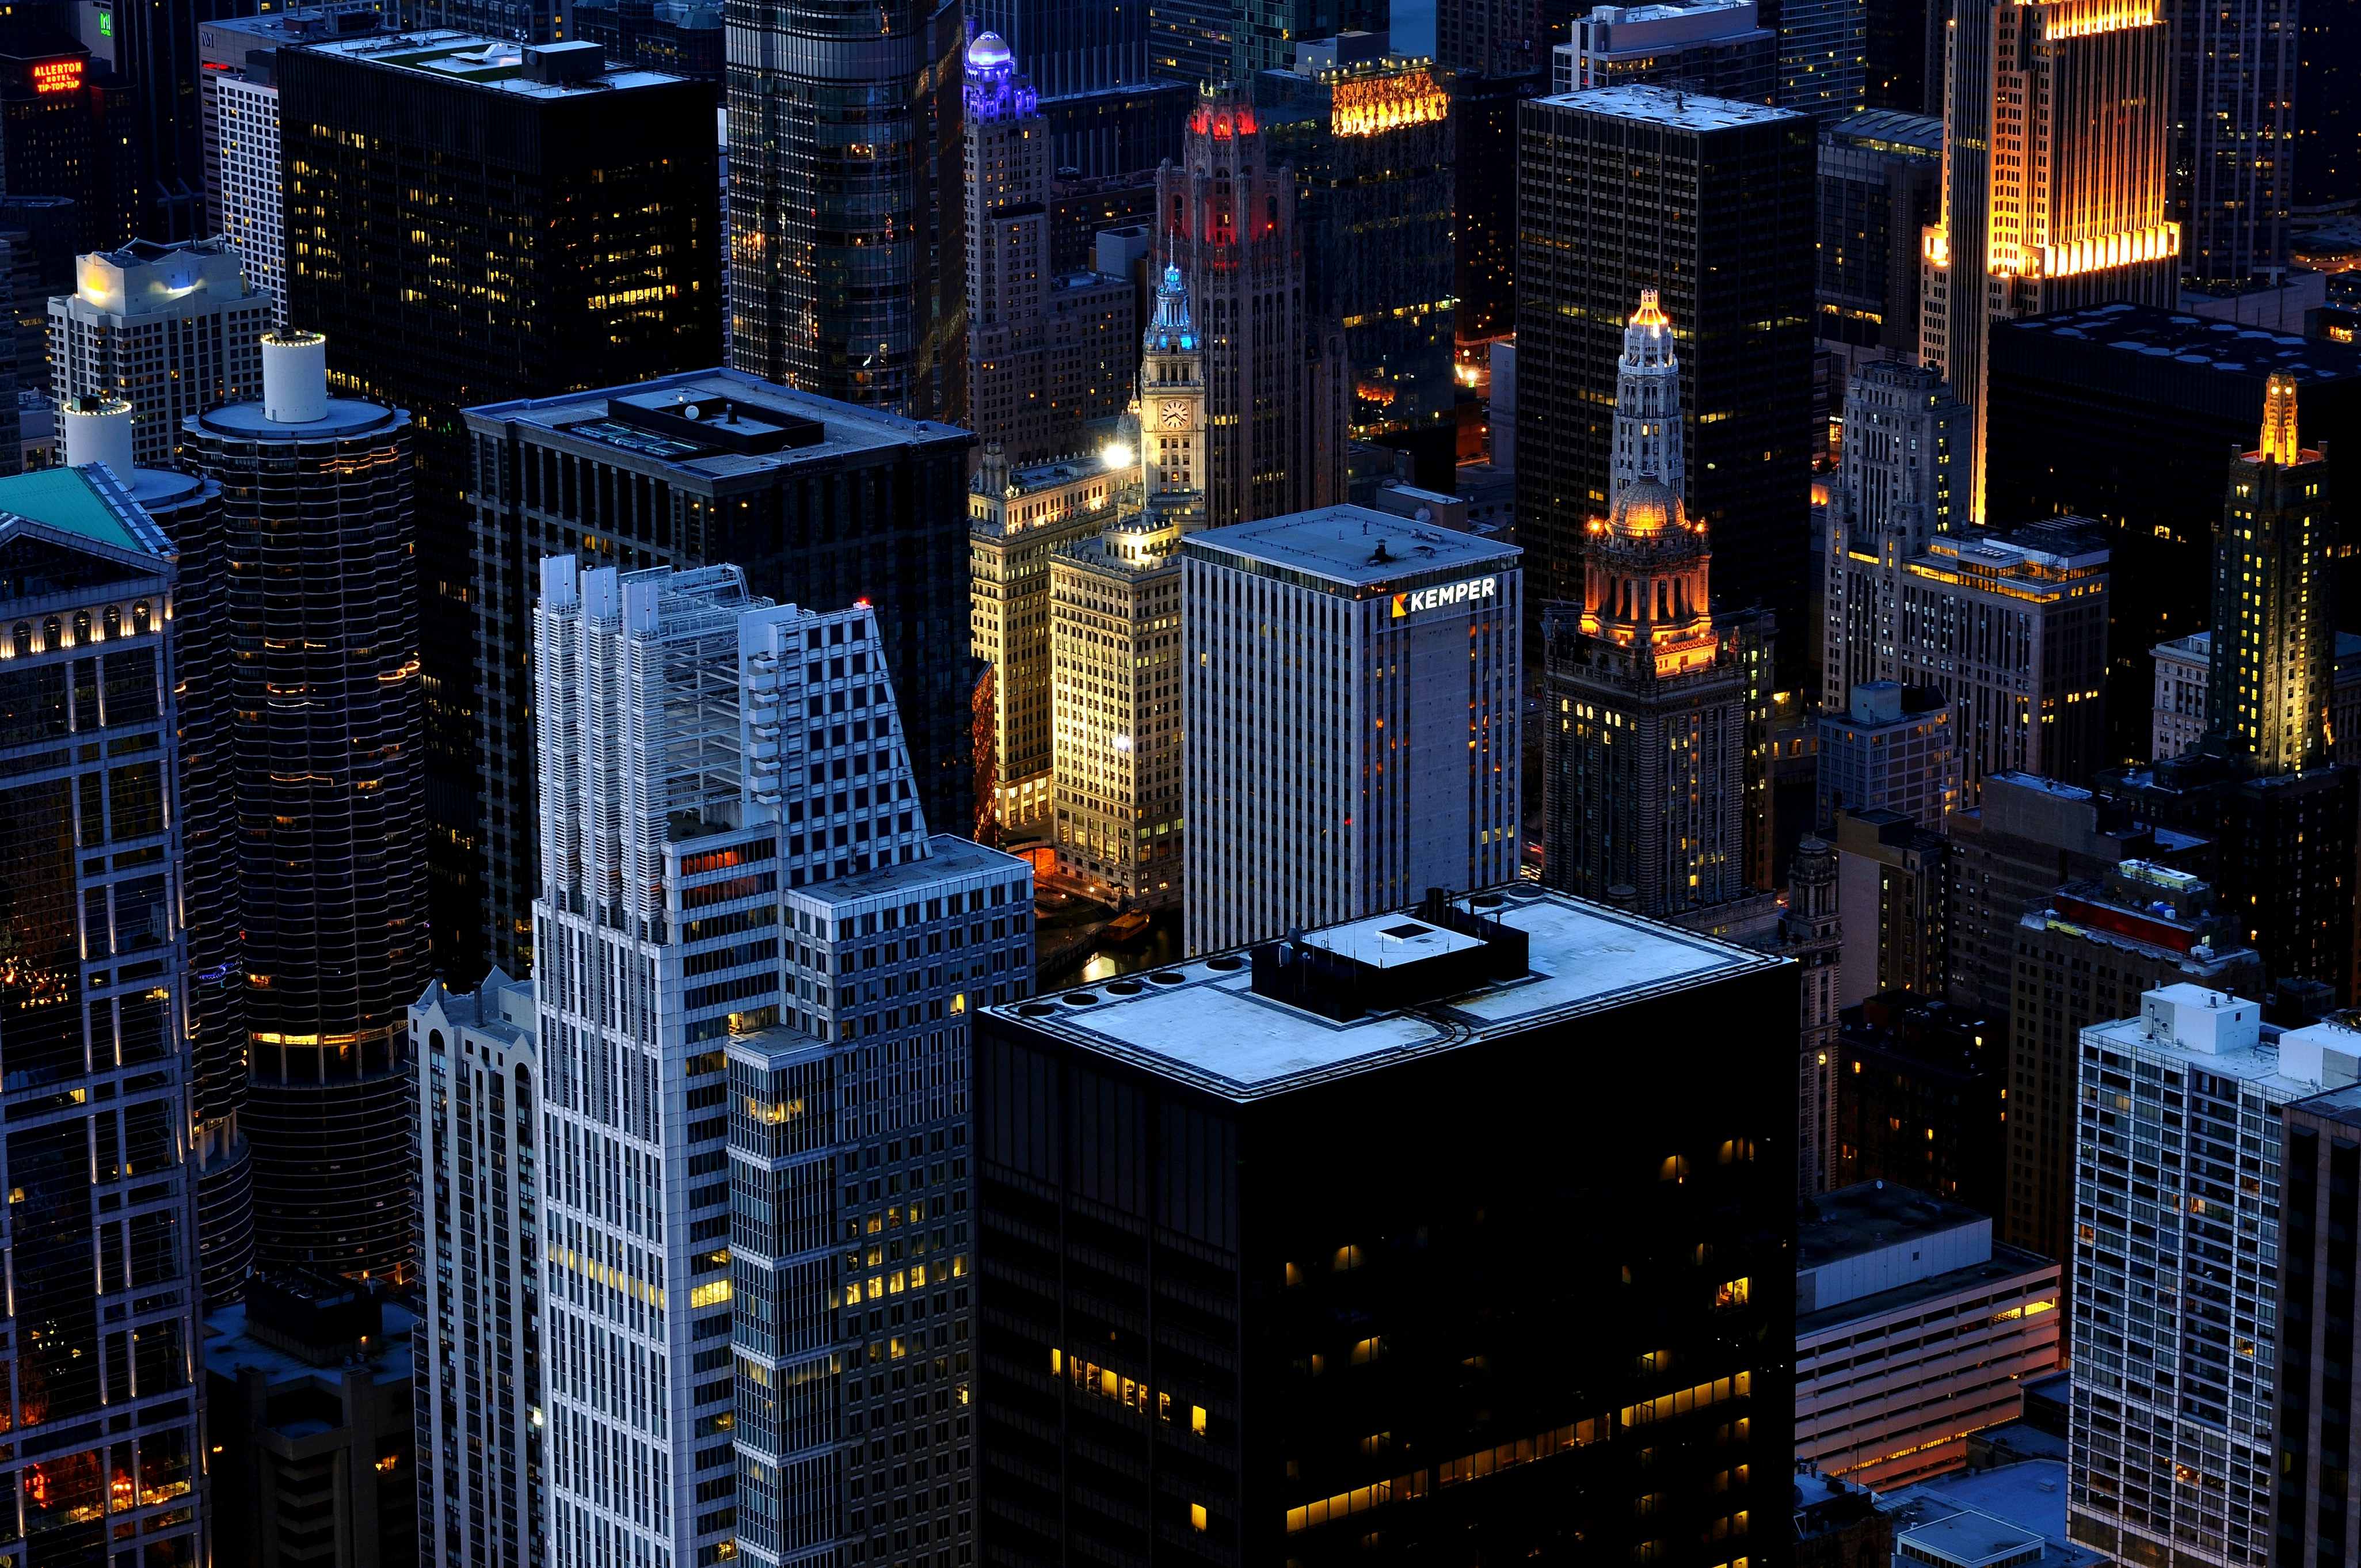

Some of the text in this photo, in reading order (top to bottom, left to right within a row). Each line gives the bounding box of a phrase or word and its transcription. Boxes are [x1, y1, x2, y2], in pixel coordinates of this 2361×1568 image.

[35, 62, 82, 77] ALLERTON
[46, 74, 71, 82] HOTEL
[1411, 577, 1495, 612] KEMPER
